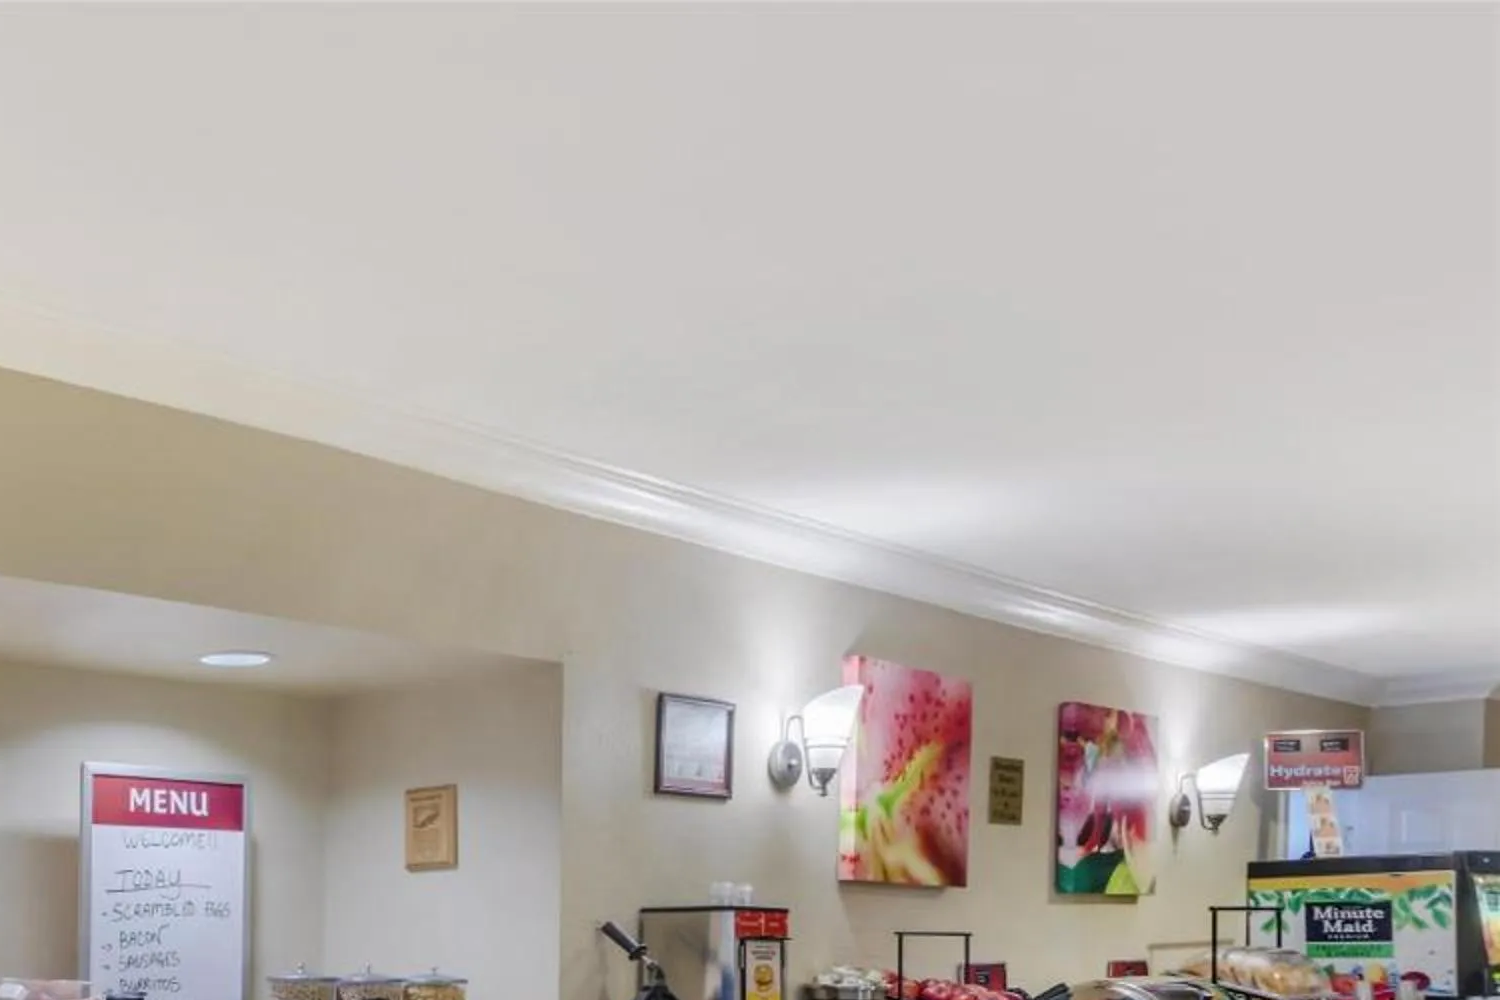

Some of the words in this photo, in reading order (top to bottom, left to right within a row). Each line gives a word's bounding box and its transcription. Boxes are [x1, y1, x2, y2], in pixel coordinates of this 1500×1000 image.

[1269, 765, 1342, 780] Hydrate
[128, 787, 210, 817] MENU
[1312, 906, 1385, 921] Minute
[1322, 920, 1375, 934] Maid
